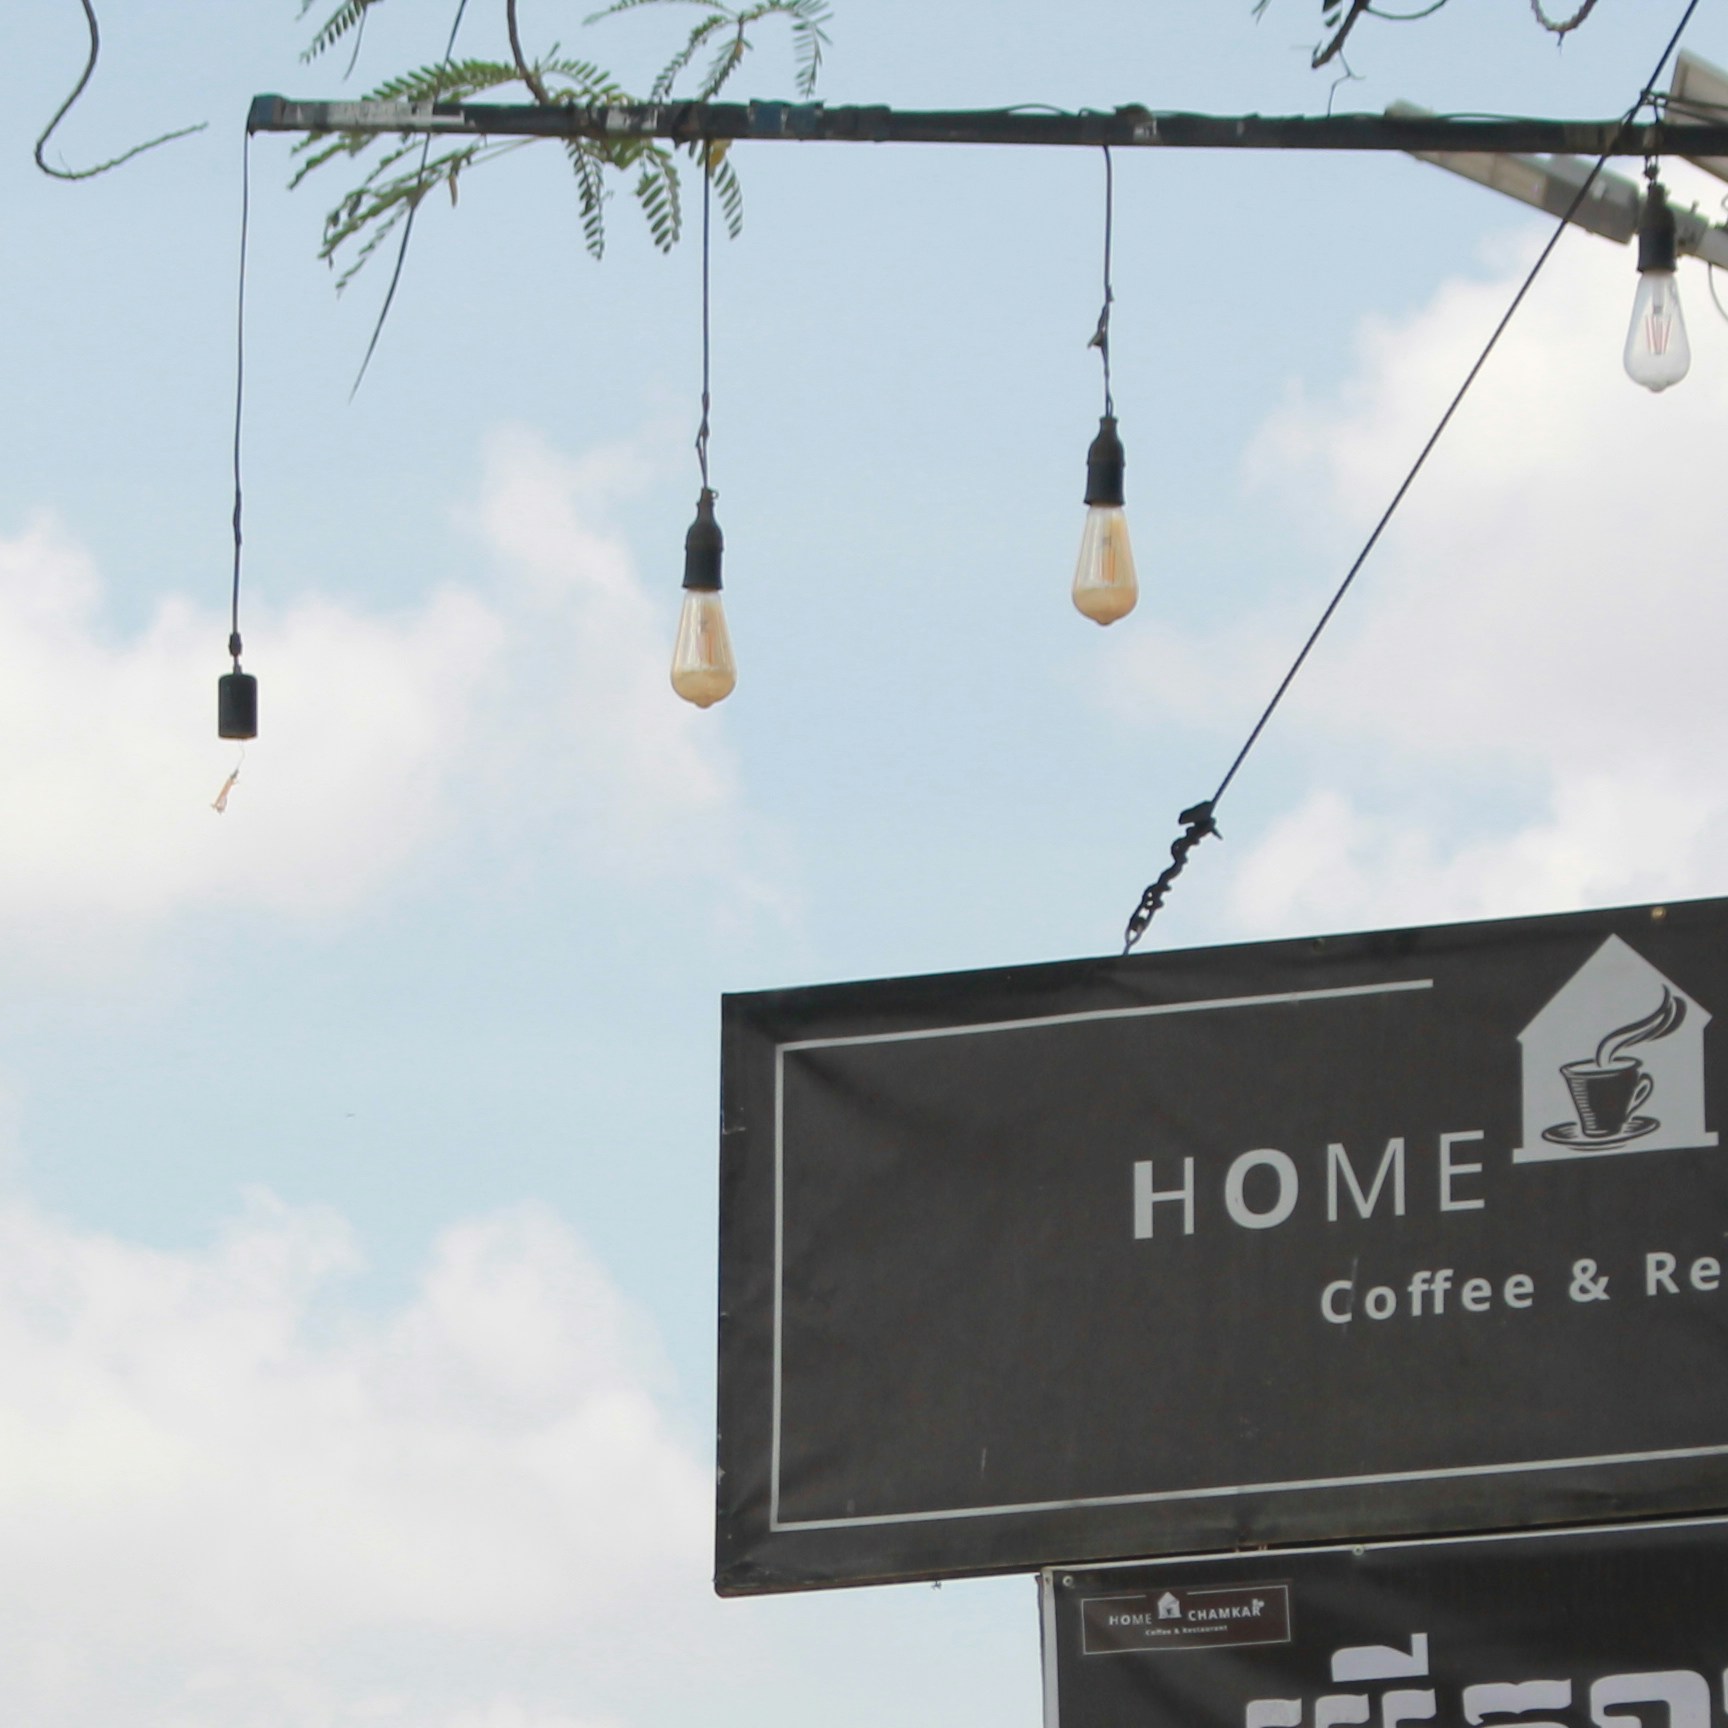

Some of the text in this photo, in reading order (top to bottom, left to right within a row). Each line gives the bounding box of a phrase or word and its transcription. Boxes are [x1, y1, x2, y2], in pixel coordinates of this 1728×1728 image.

[1133, 1129, 1485, 1239] HOME
[1321, 1268, 1534, 1324] Coffee
[1569, 1258, 1610, 1302] &
[1108, 1605, 1261, 1626] HOME CHAMKAR
